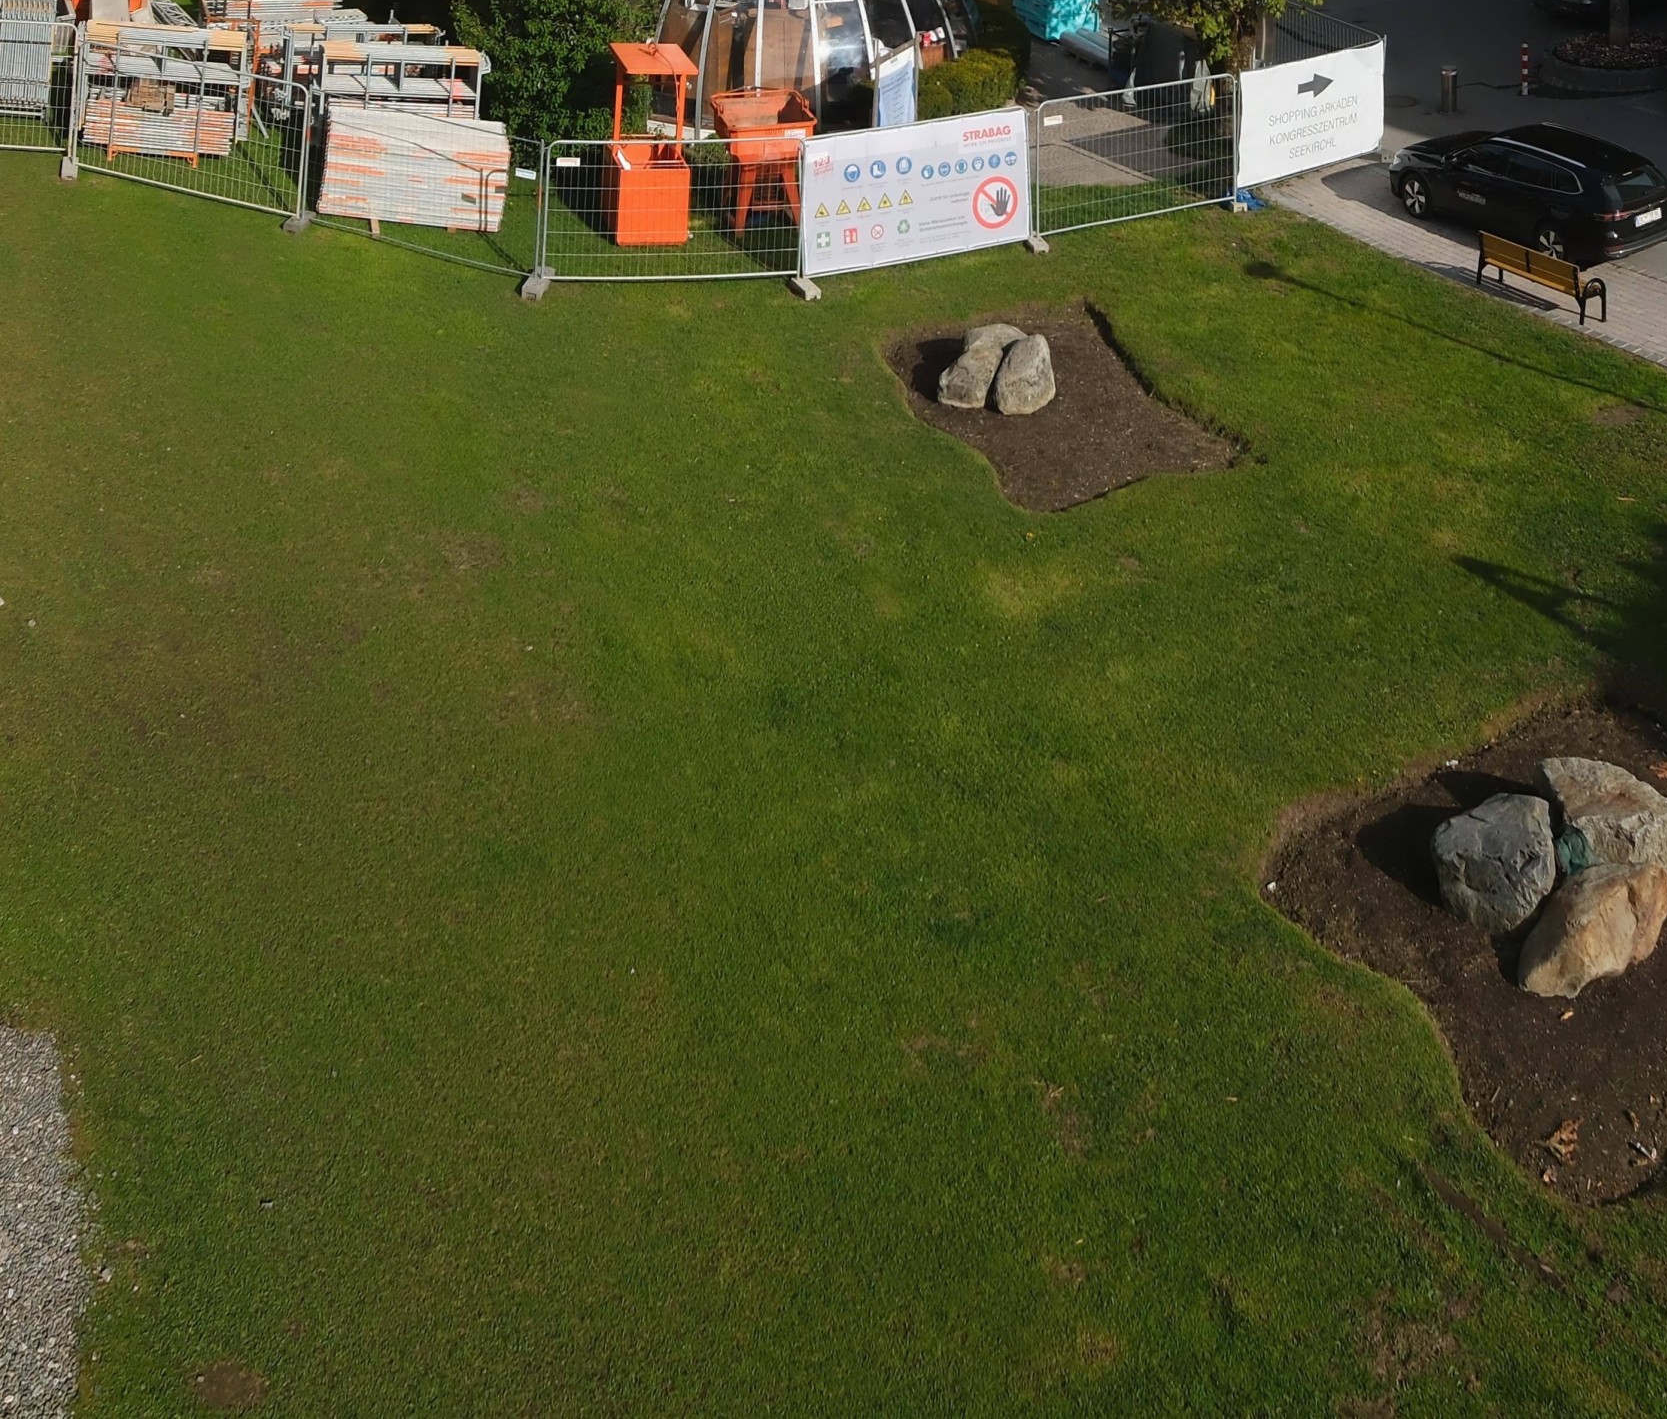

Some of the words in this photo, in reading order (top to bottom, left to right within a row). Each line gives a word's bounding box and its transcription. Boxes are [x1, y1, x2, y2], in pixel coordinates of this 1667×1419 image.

[1269, 106, 1317, 127] SHOPPING
[1319, 95, 1358, 115] ARKADEN
[962, 125, 1011, 142] STRABAG
[1269, 113, 1358, 146] KONGRESSZENTRUM
[1289, 137, 1337, 159] SEEKIRCHL
